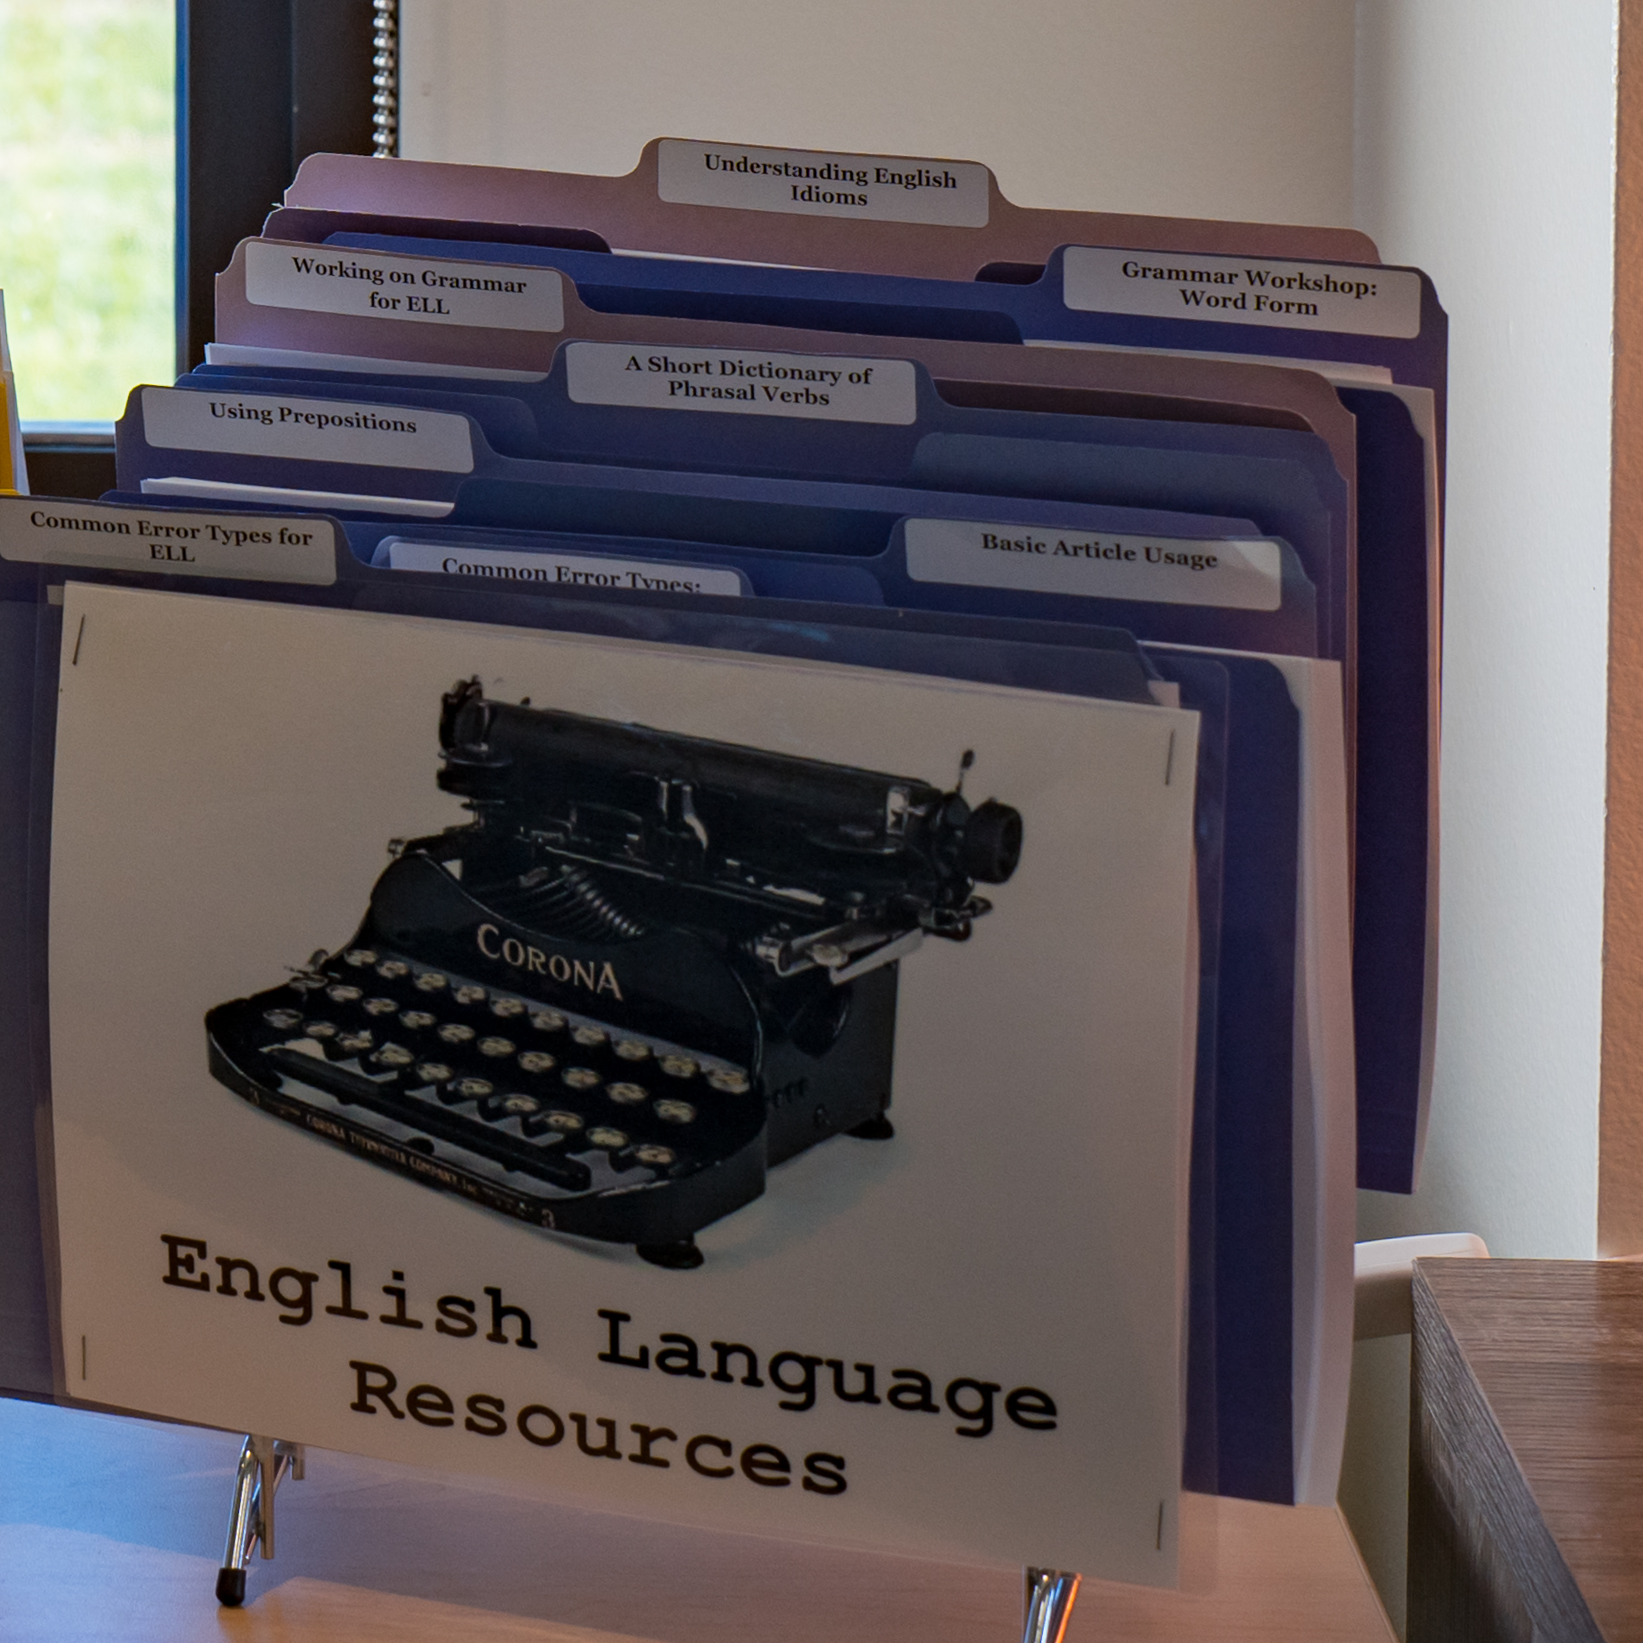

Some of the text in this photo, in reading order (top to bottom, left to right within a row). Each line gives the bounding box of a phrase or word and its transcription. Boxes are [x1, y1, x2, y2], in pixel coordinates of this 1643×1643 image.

[705, 154, 956, 189] Understanding English
[792, 185, 867, 205] Idioms
[292, 257, 526, 293] Working on Grammar
[1123, 262, 1376, 299] Grammar Workshop:
[370, 292, 449, 314] for ELL
[1180, 290, 1317, 315] Word Form
[626, 356, 873, 386] A Short Dictionary of
[669, 381, 829, 405] Phrasal Verbs
[210, 403, 416, 432] Using Prepositions
[31, 512, 312, 546] Common Error Types for
[150, 545, 195, 562] ELL
[982, 534, 1217, 570] Basic Article Usage
[475, 922, 625, 1002] CORONA
[161, 1234, 1057, 1438] English Language
[349, 1361, 847, 1495] Resources
